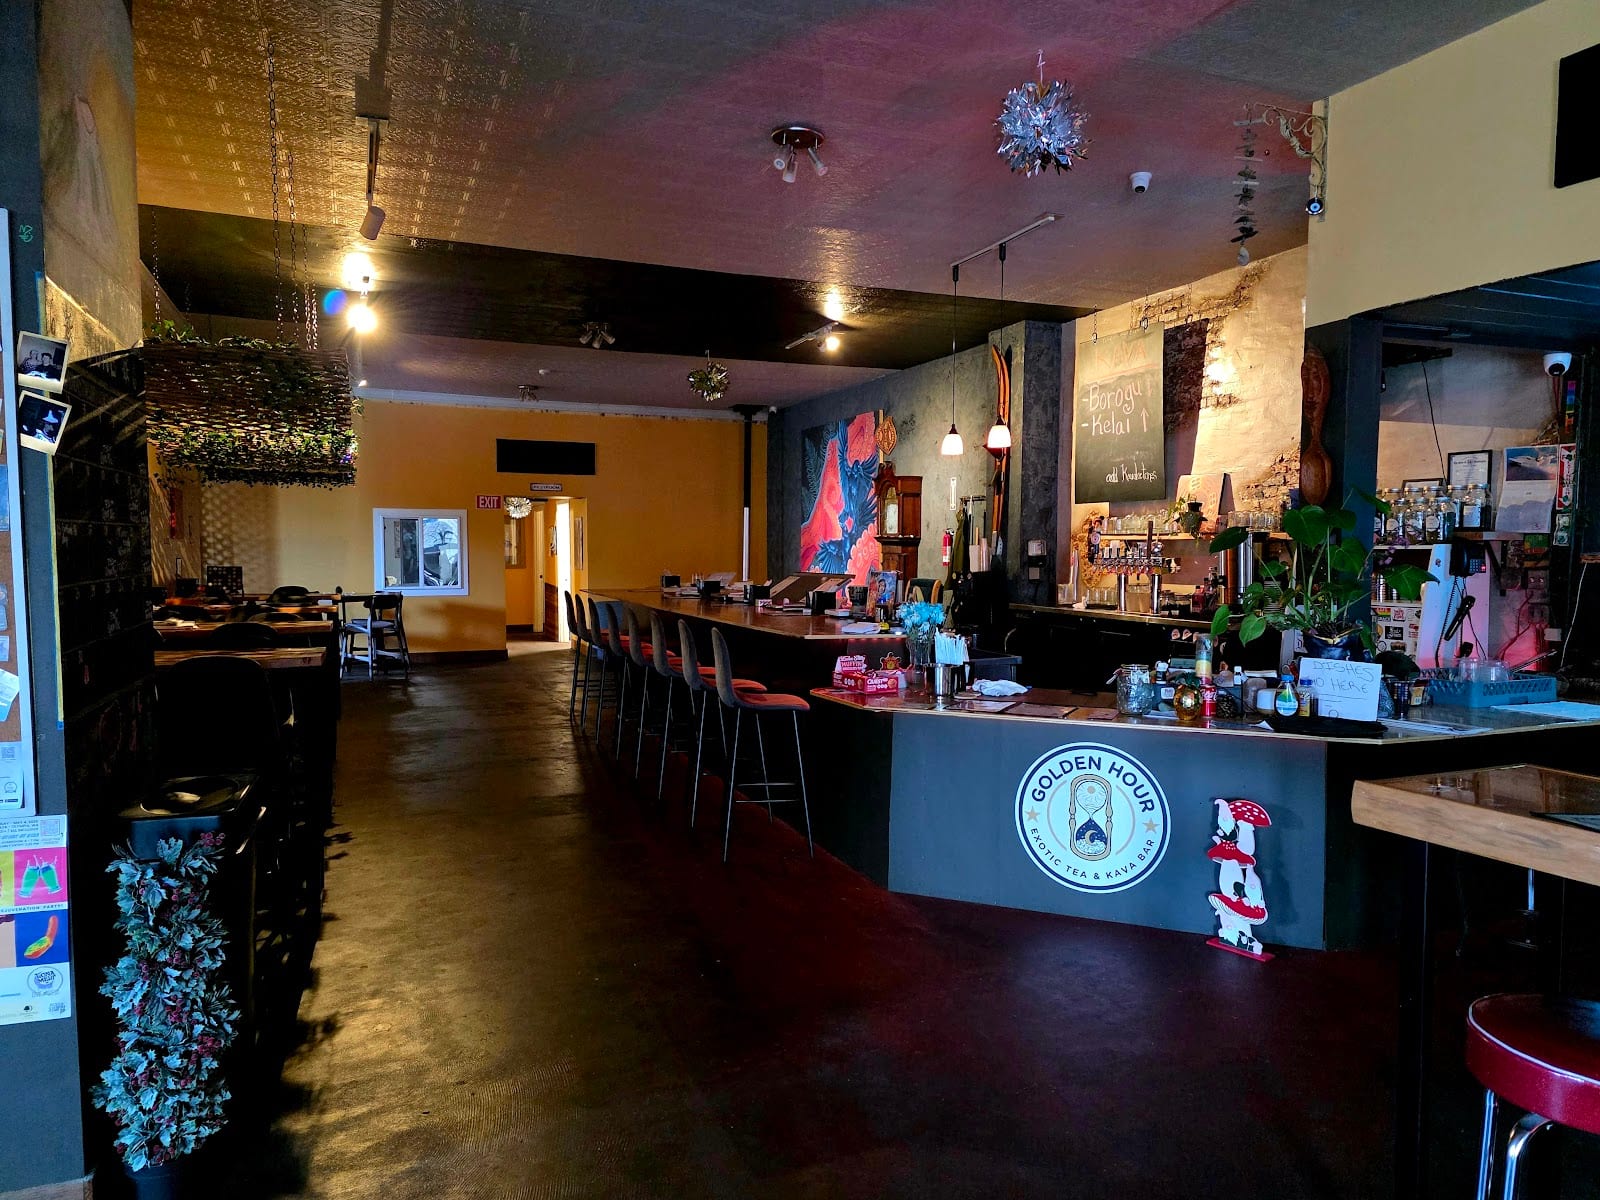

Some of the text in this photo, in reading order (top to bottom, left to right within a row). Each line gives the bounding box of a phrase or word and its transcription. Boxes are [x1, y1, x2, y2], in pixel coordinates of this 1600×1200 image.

[479, 496, 499, 509] EXIT
[1313, 660, 1375, 683] DISHES
[1330, 678, 1369, 694] HERE
[1031, 755, 1155, 813] GOLDEN HOUR
[1030, 827, 1155, 880] EXOTIC TEA & KAVA BAR
